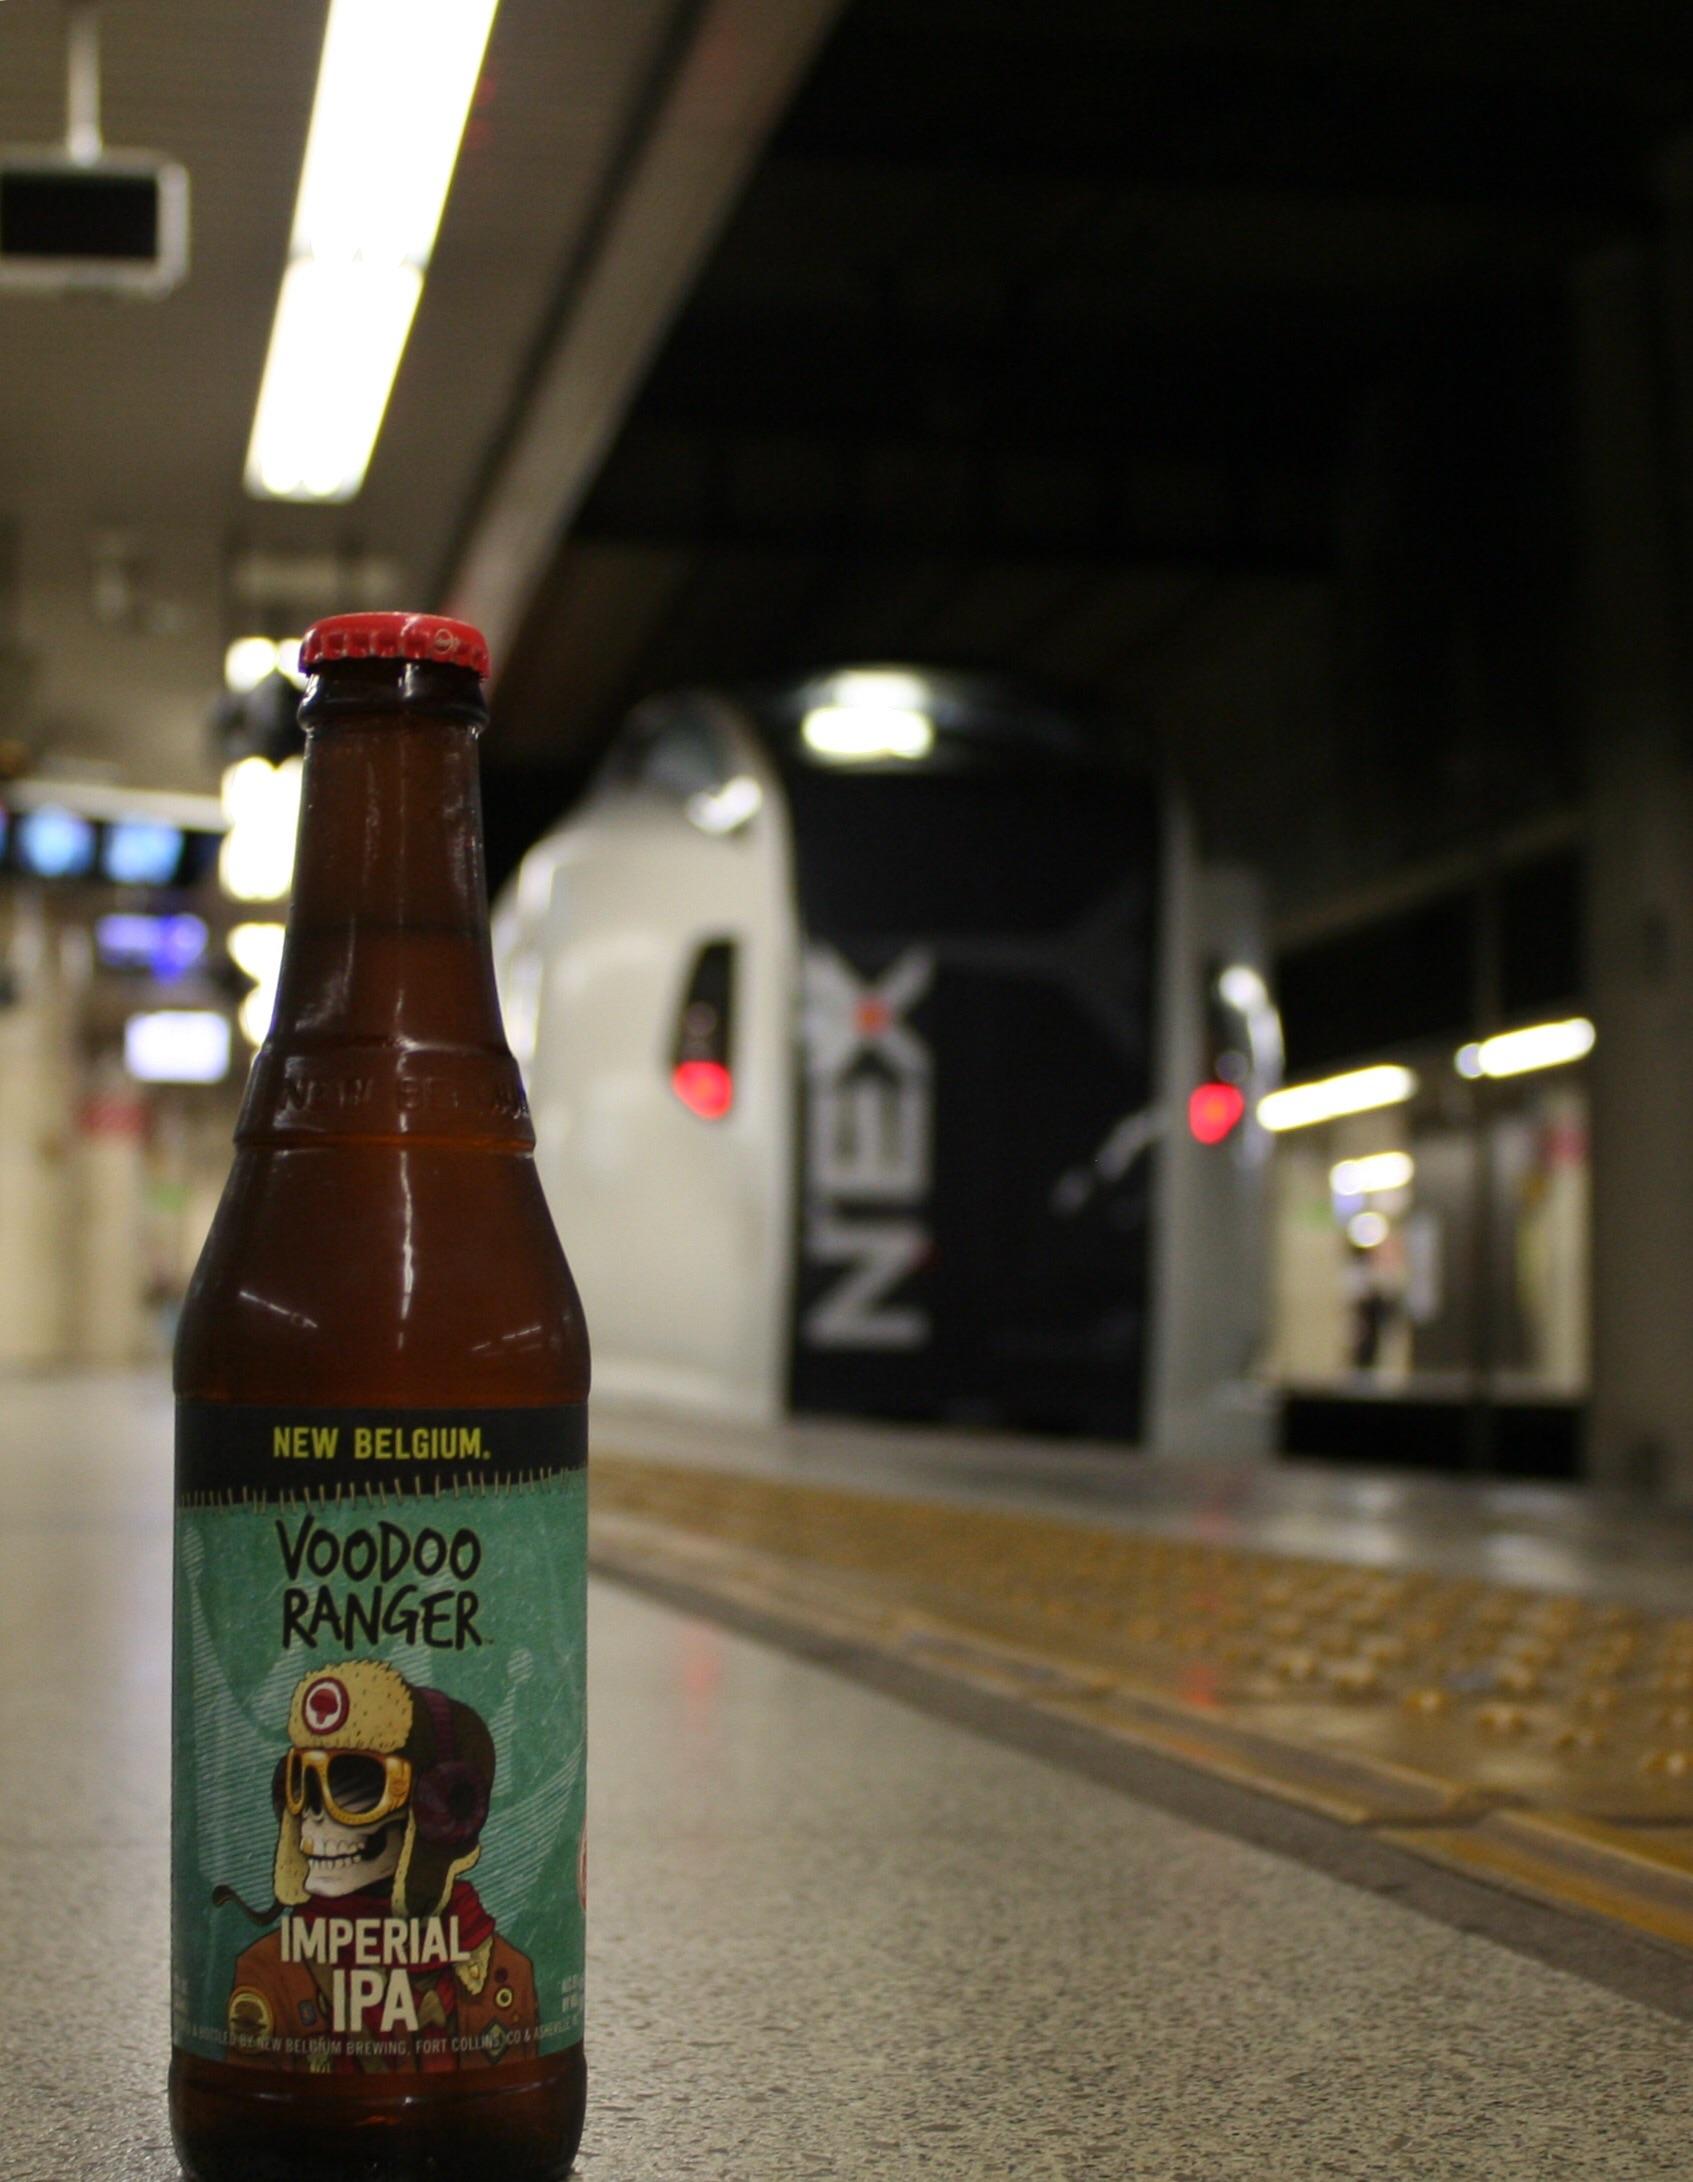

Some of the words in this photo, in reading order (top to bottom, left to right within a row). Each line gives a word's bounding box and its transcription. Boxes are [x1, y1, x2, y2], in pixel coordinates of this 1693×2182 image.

[273, 1427, 338, 1459] NEW
[275, 1513, 482, 1582] VOODOO
[282, 1585, 482, 1651] RANGER
[280, 1914, 471, 1965] IMPERIAL
[332, 1969, 419, 2033] IPA
[286, 2037, 342, 2055] BELGIUM
[415, 2038, 447, 2054] FORT
[506, 2029, 522, 2045] CO
